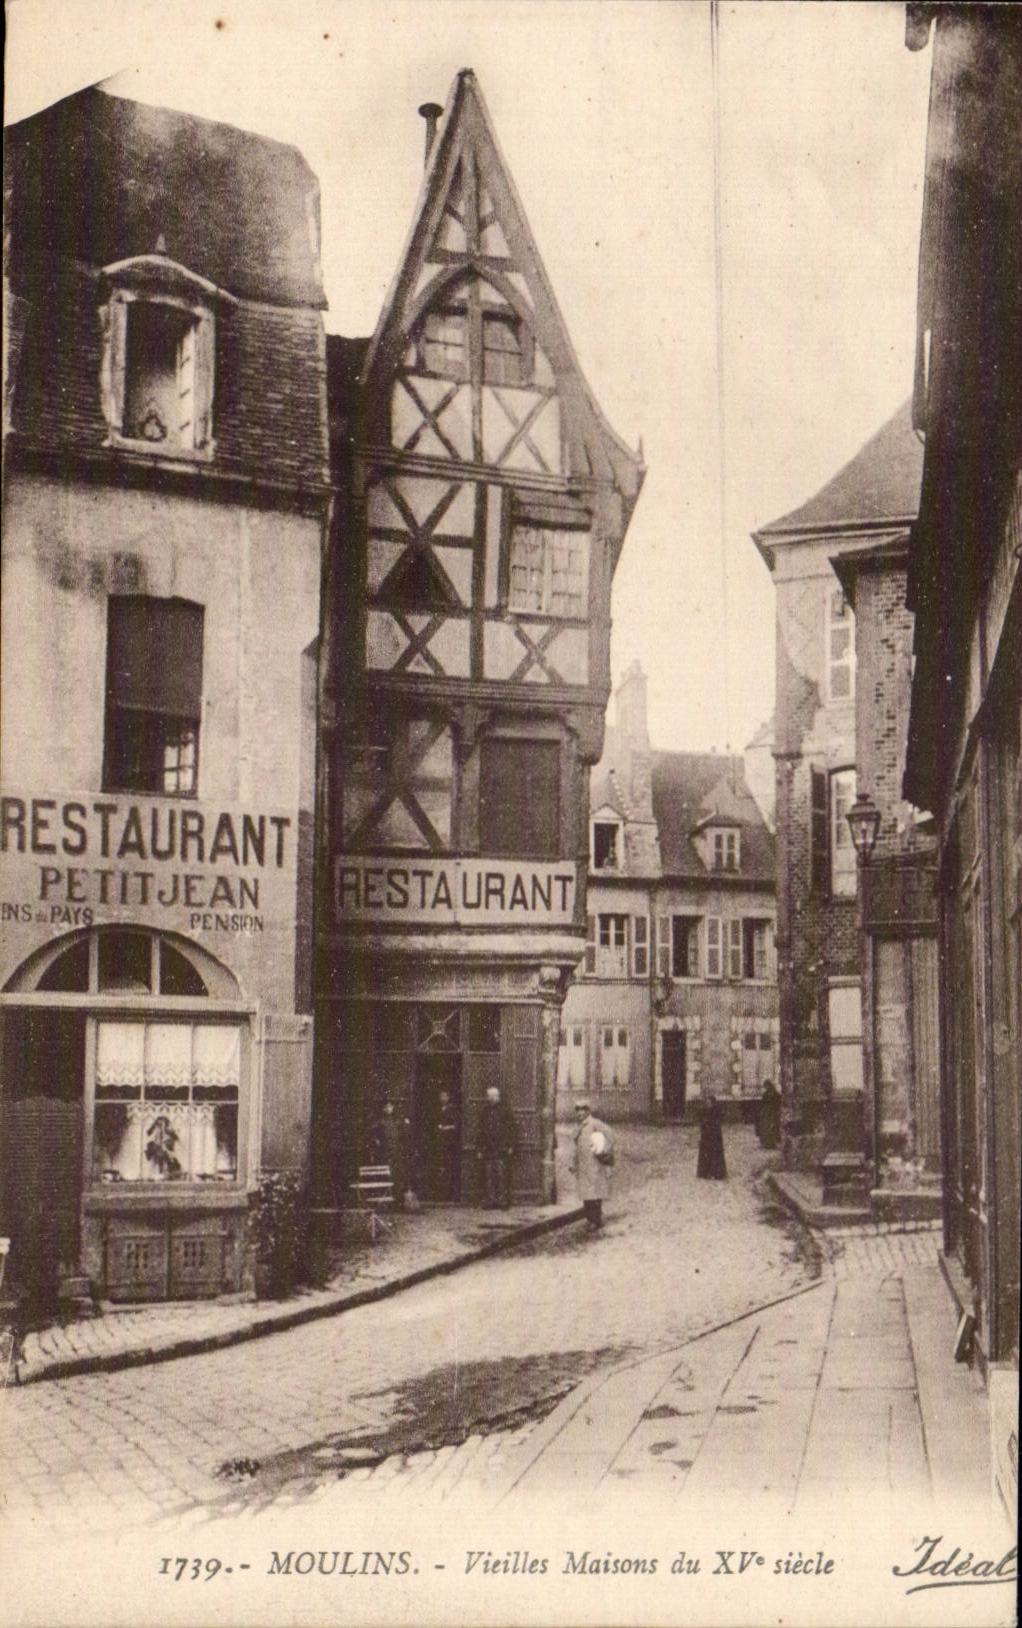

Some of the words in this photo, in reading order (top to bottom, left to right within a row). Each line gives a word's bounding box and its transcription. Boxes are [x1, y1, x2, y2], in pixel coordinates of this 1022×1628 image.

[2, 797, 291, 868] RESTAURANT
[339, 867, 574, 911] RESTAURANT
[50, 905, 94, 926] PAYS
[190, 913, 264, 932] PENSION
